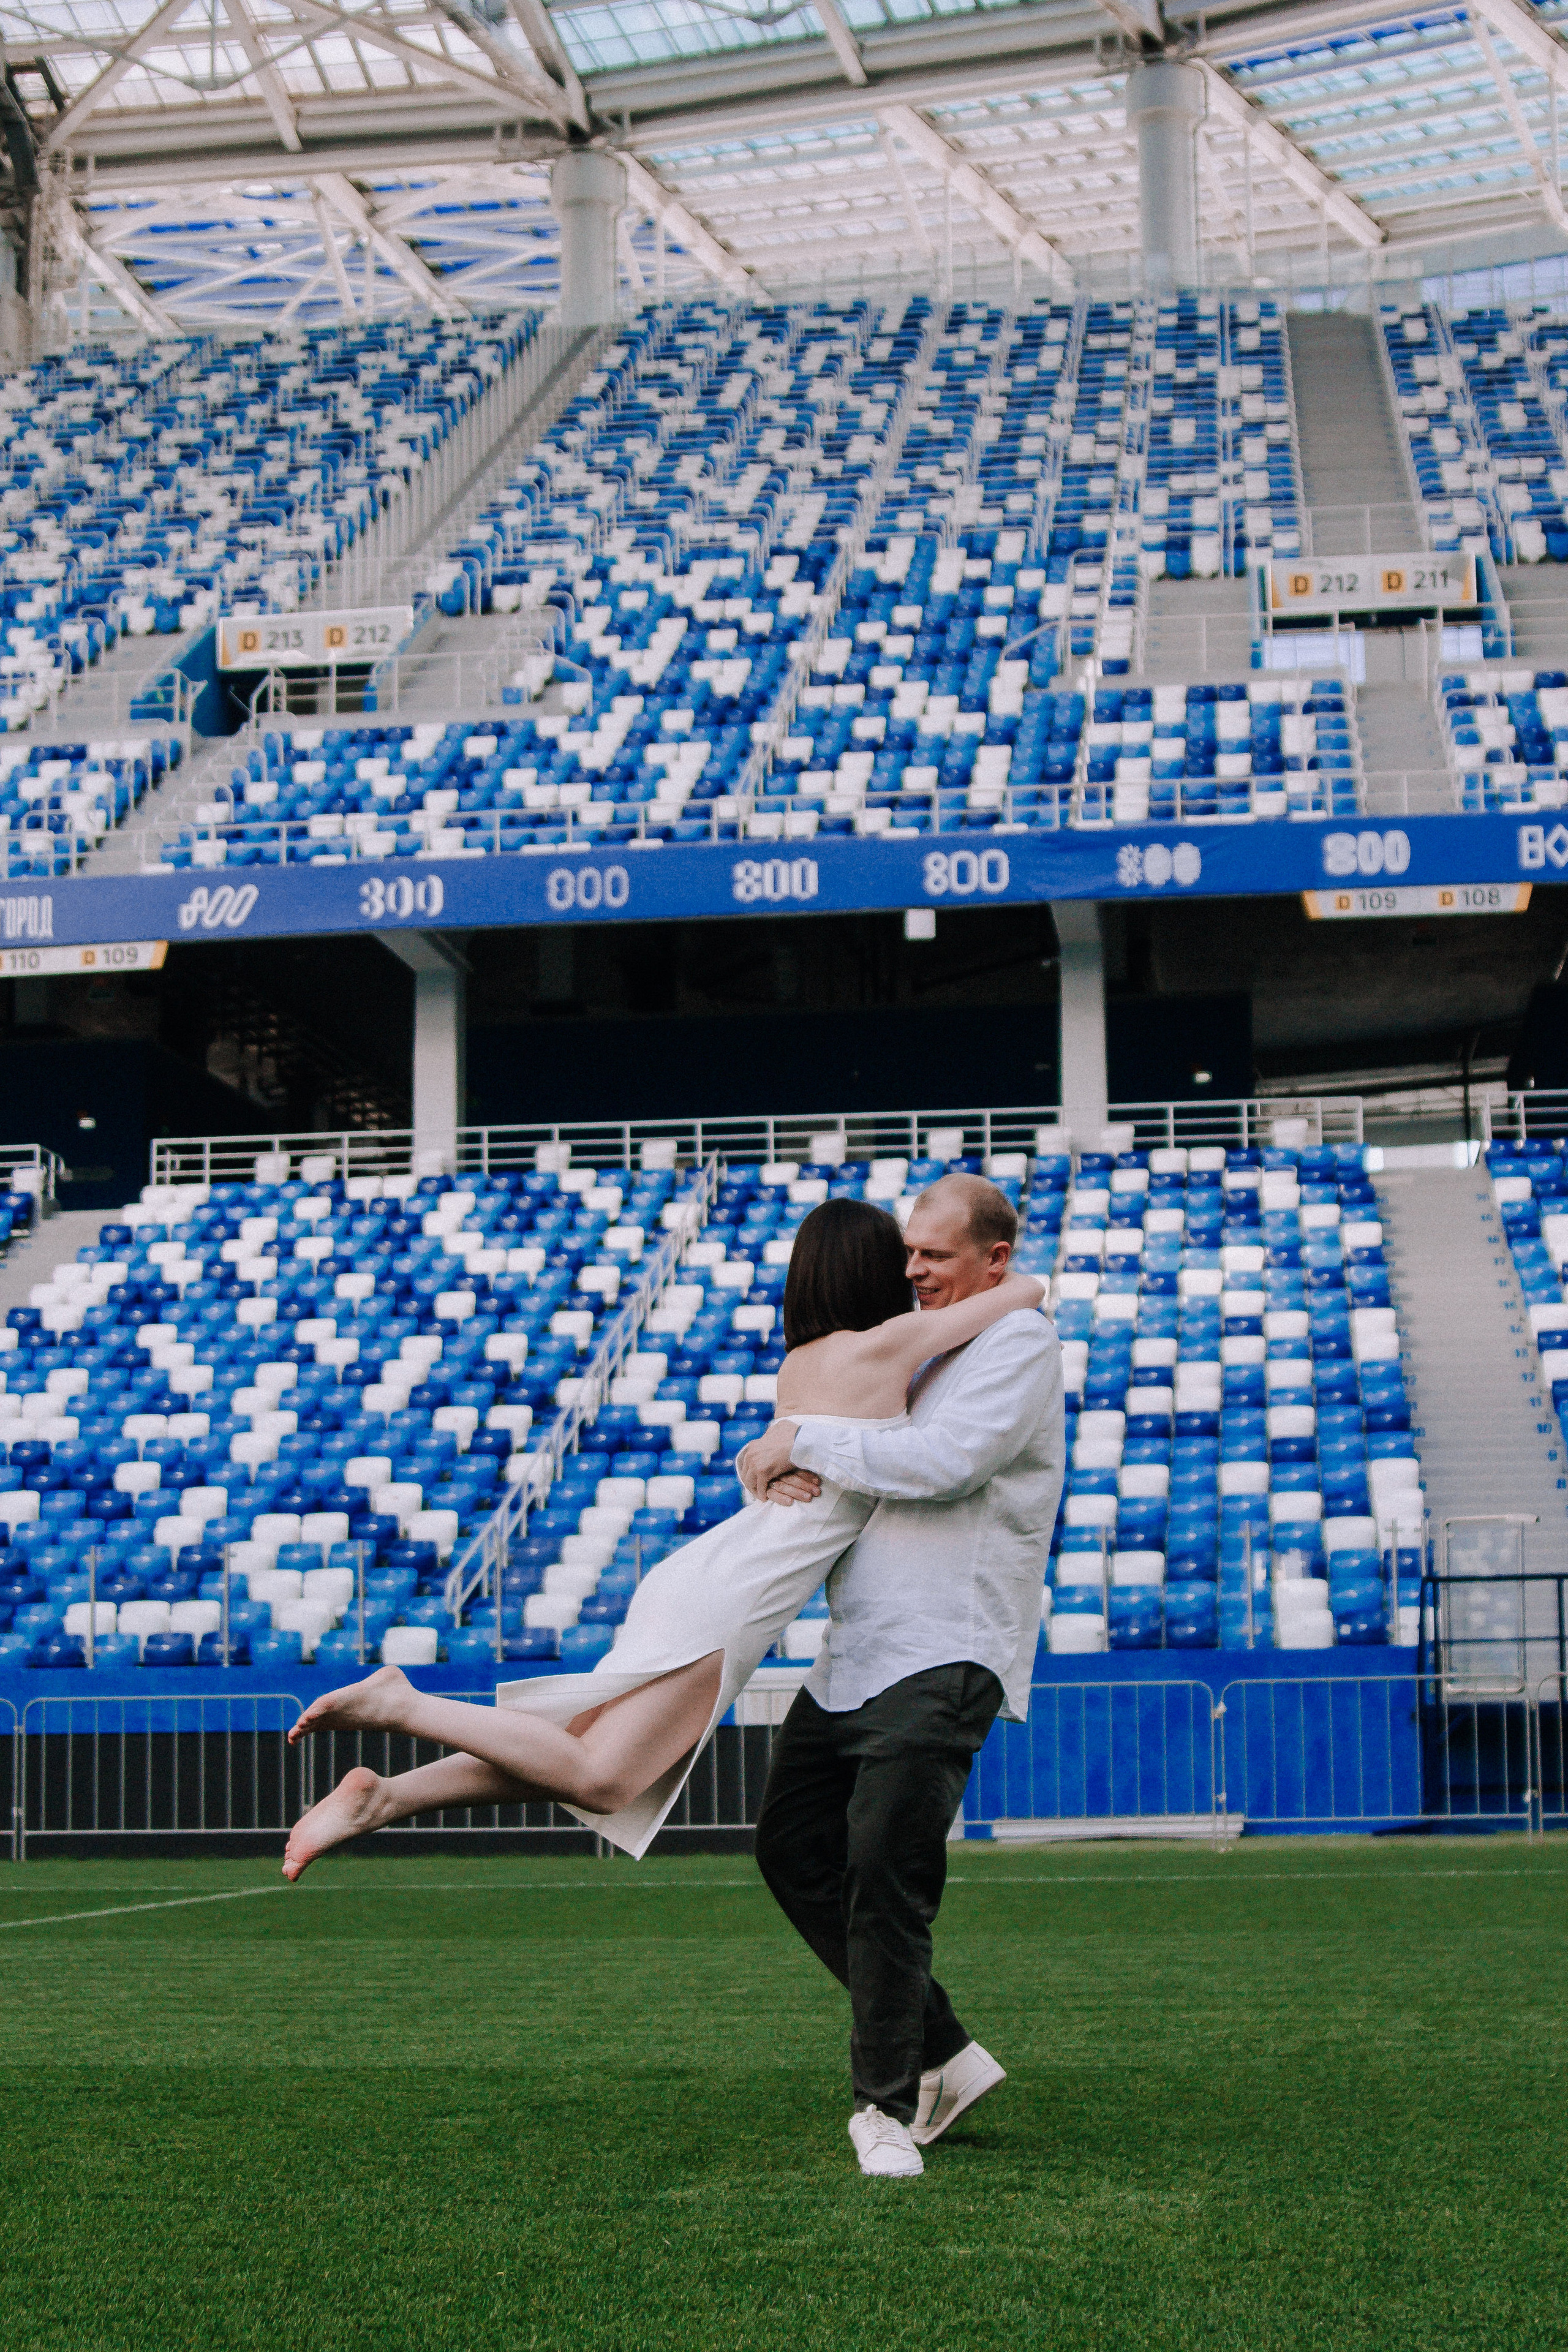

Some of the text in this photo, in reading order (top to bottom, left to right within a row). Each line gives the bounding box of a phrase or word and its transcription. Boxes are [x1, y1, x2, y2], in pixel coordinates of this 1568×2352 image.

[1293, 569, 1449, 594] D 212 D 211
[243, 624, 391, 650] D 213 D 212
[732, 858, 819, 903] 800
[923, 848, 1010, 897] 800
[1321, 830, 1411, 877] 800
[1339, 888, 1501, 911] D 109 D 108
[9, 951, 40, 970] 110
[83, 950, 95, 965] D
[103, 946, 138, 965] 109
